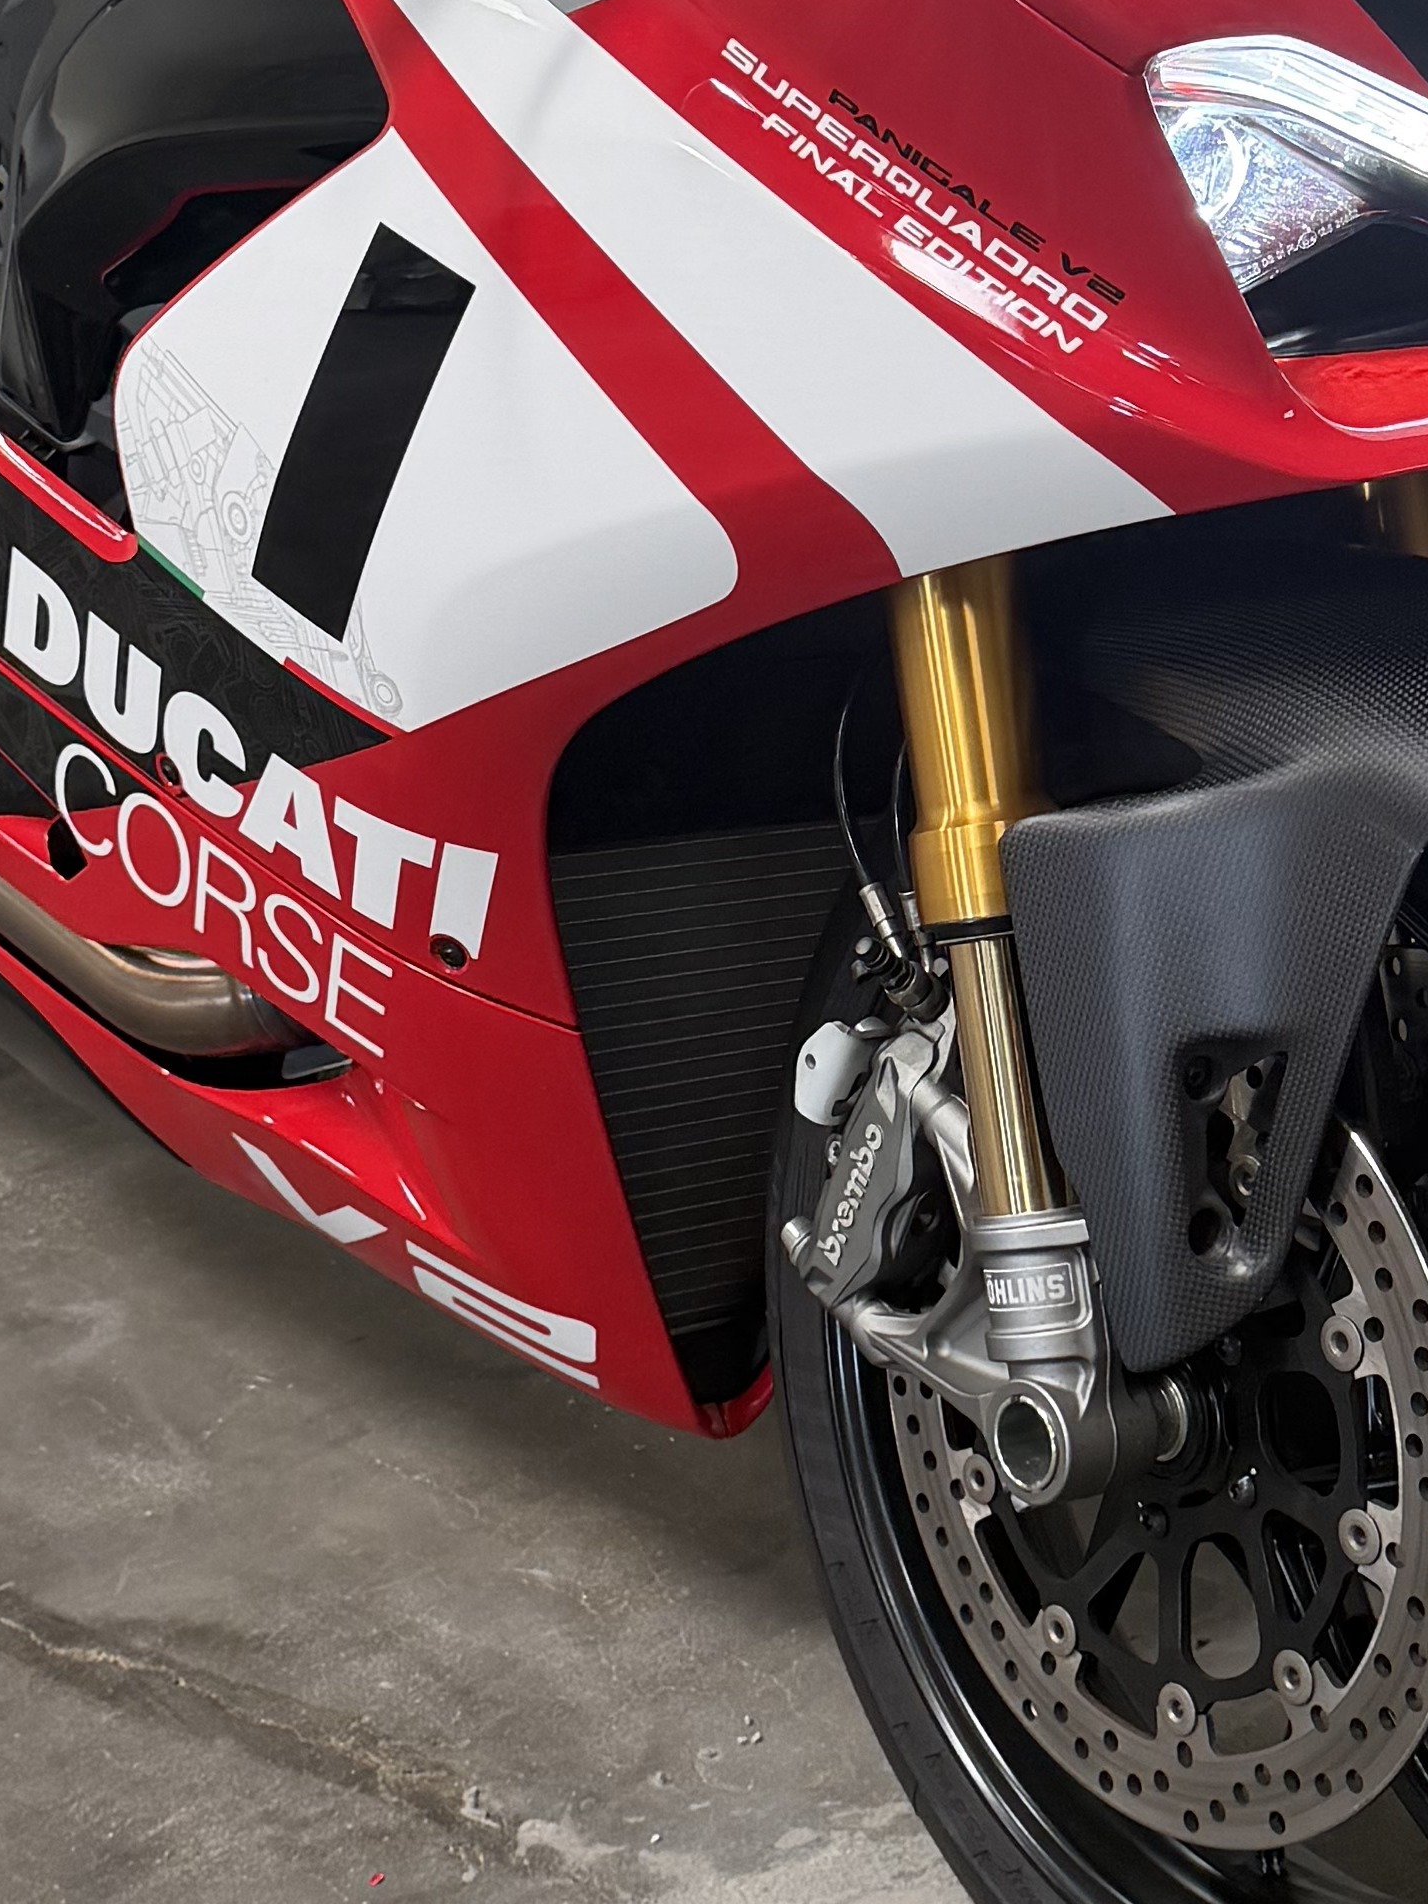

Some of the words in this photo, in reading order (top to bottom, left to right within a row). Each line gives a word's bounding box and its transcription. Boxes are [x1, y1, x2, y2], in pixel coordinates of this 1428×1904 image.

[721, 38, 1109, 332] SUPERQUADRO
[762, 113, 884, 218] FINAL
[894, 215, 1084, 354] EDITION
[828, 89, 1046, 253] PANIGALE
[1061, 251, 1126, 306] V2
[3, 546, 499, 960] DUCATI
[55, 743, 393, 1058] CORSE
[232, 1132, 600, 1389] V2
[817, 1123, 884, 1267] brembo
[986, 1273, 1066, 1305] ÖHLINS
